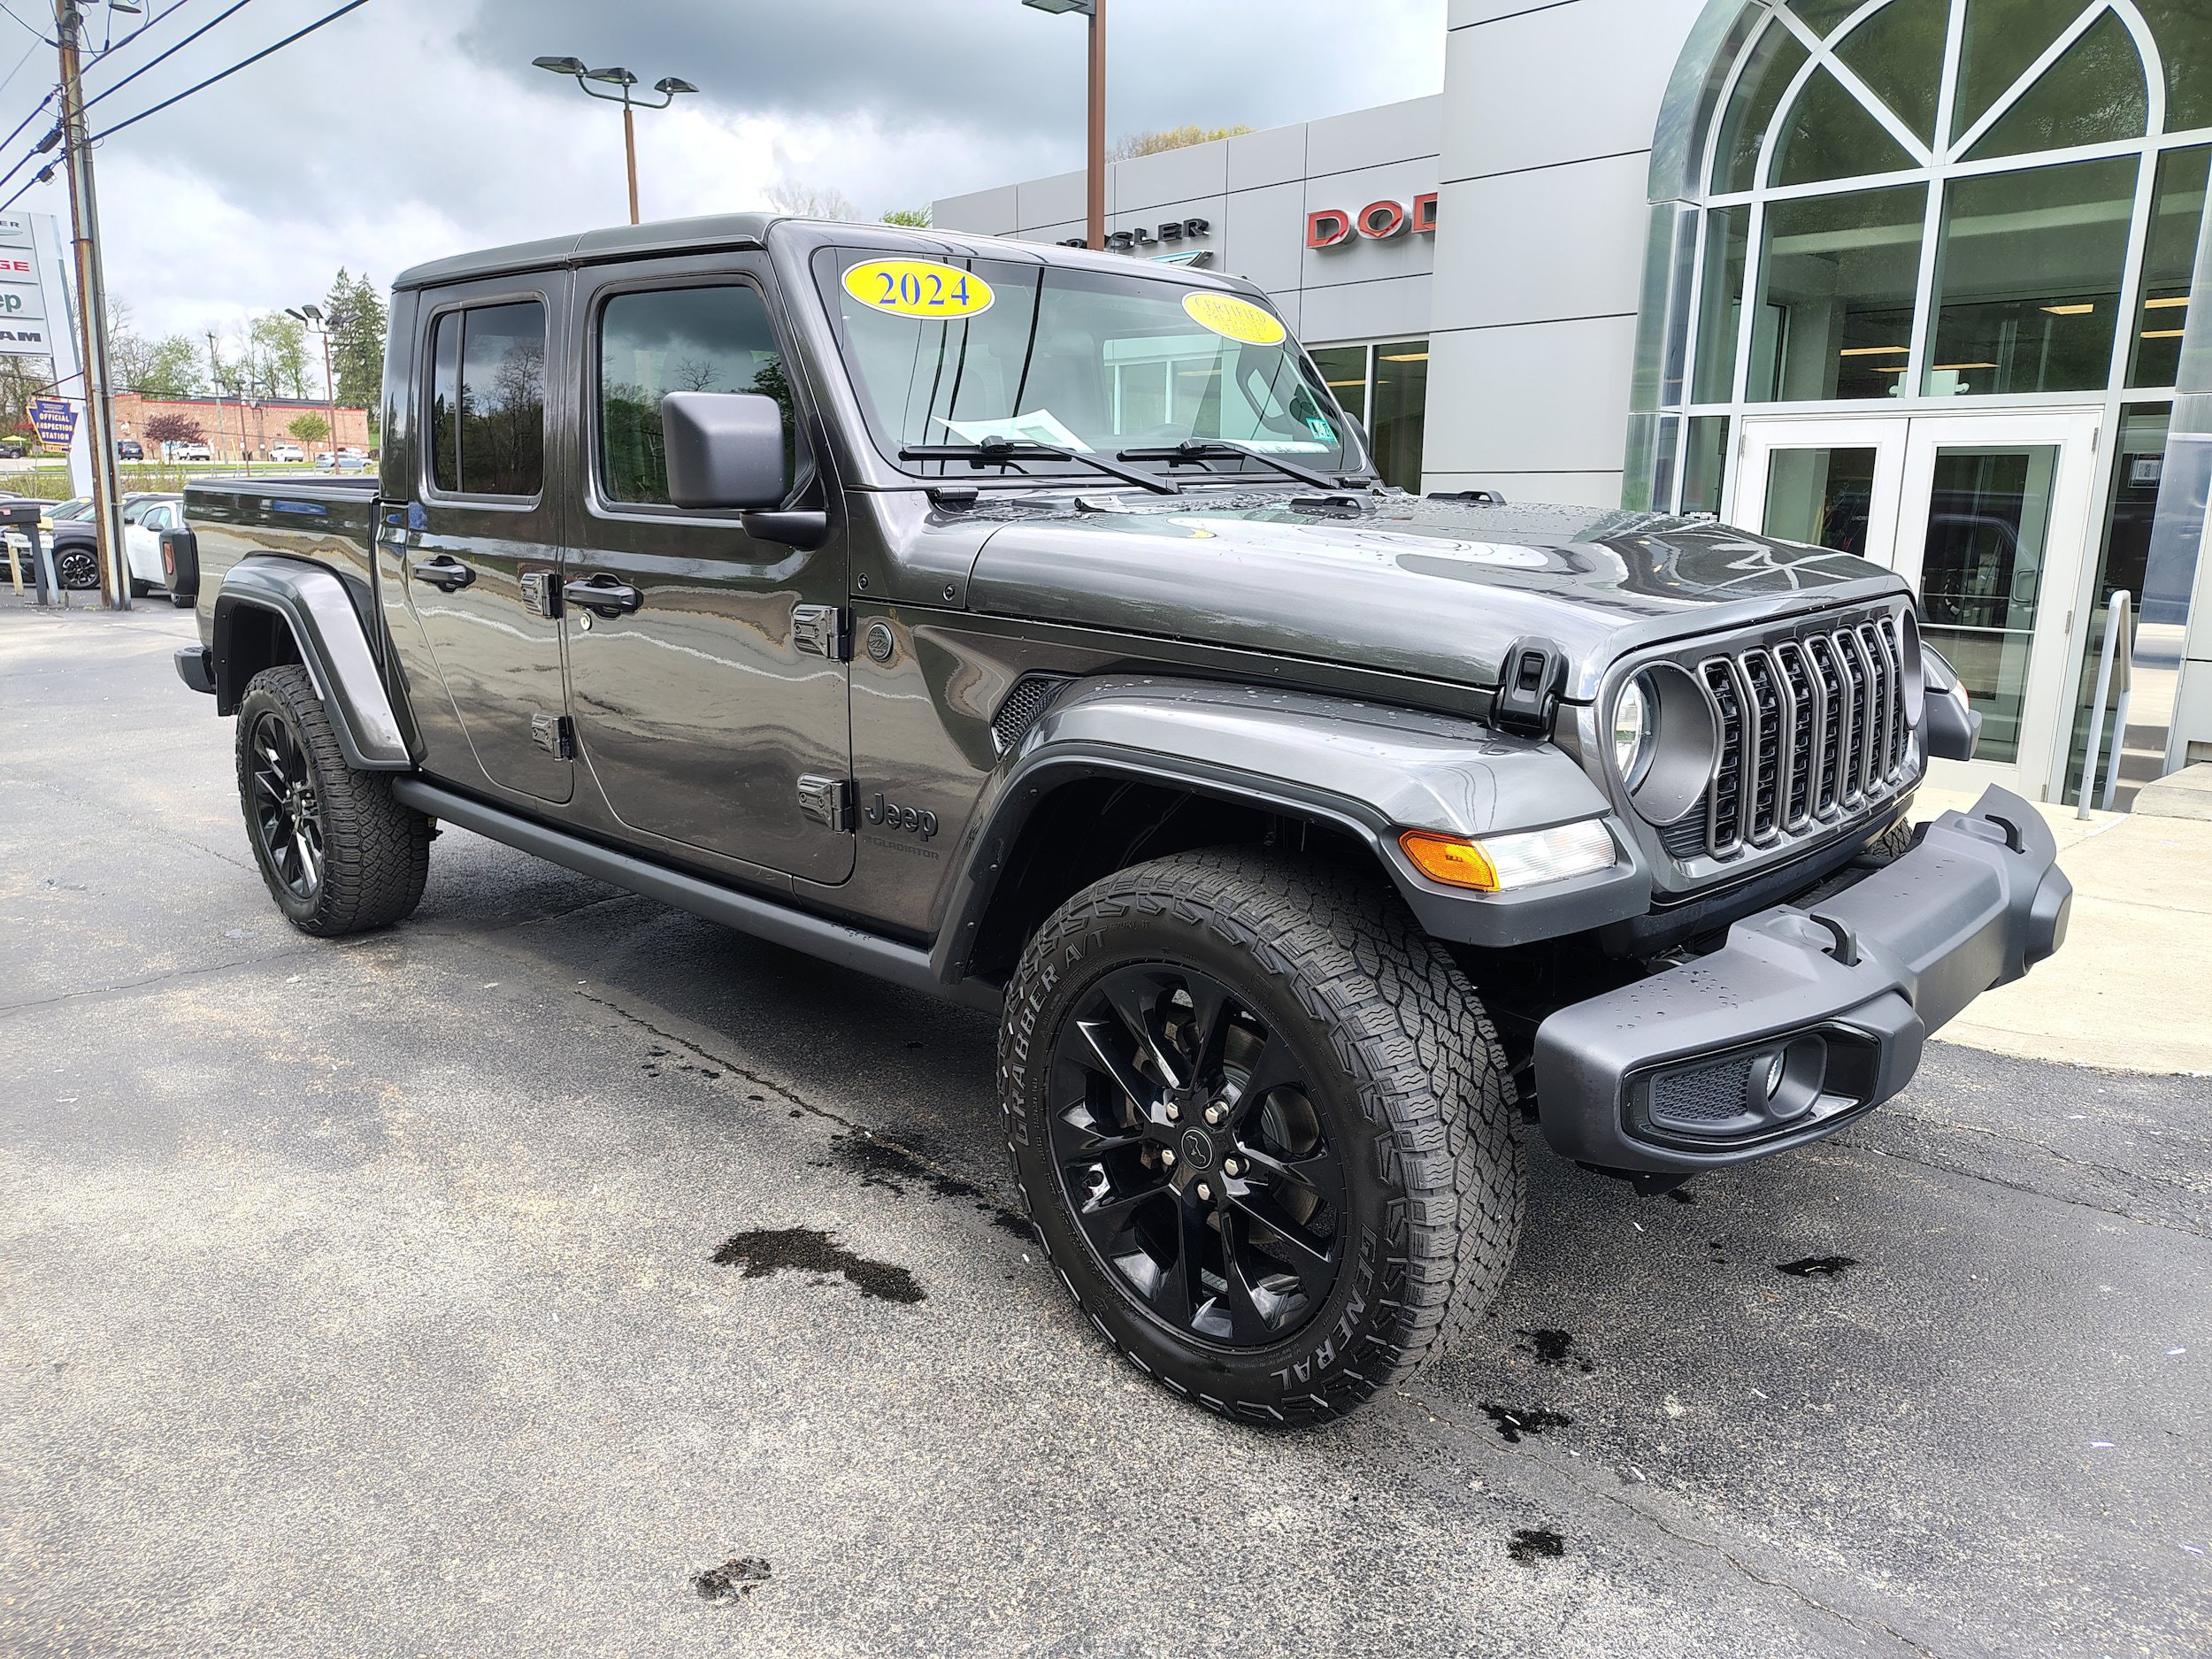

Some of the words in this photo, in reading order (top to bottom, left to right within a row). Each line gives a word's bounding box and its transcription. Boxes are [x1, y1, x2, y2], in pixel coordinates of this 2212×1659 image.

[875, 272, 970, 306] 2024
[1194, 297, 1267, 324] CERTIFIED
[35, 421, 73, 432] INSPECTION
[39, 412, 70, 422] OFFICIAL
[41, 431, 69, 441] STATION
[864, 792, 938, 842] Jeep
[872, 837, 940, 861] GLADIATOR
[1011, 962, 1061, 1147] GRABBER
[1064, 926, 1109, 970] A/T
[1270, 1222, 1378, 1391] GENERAL
